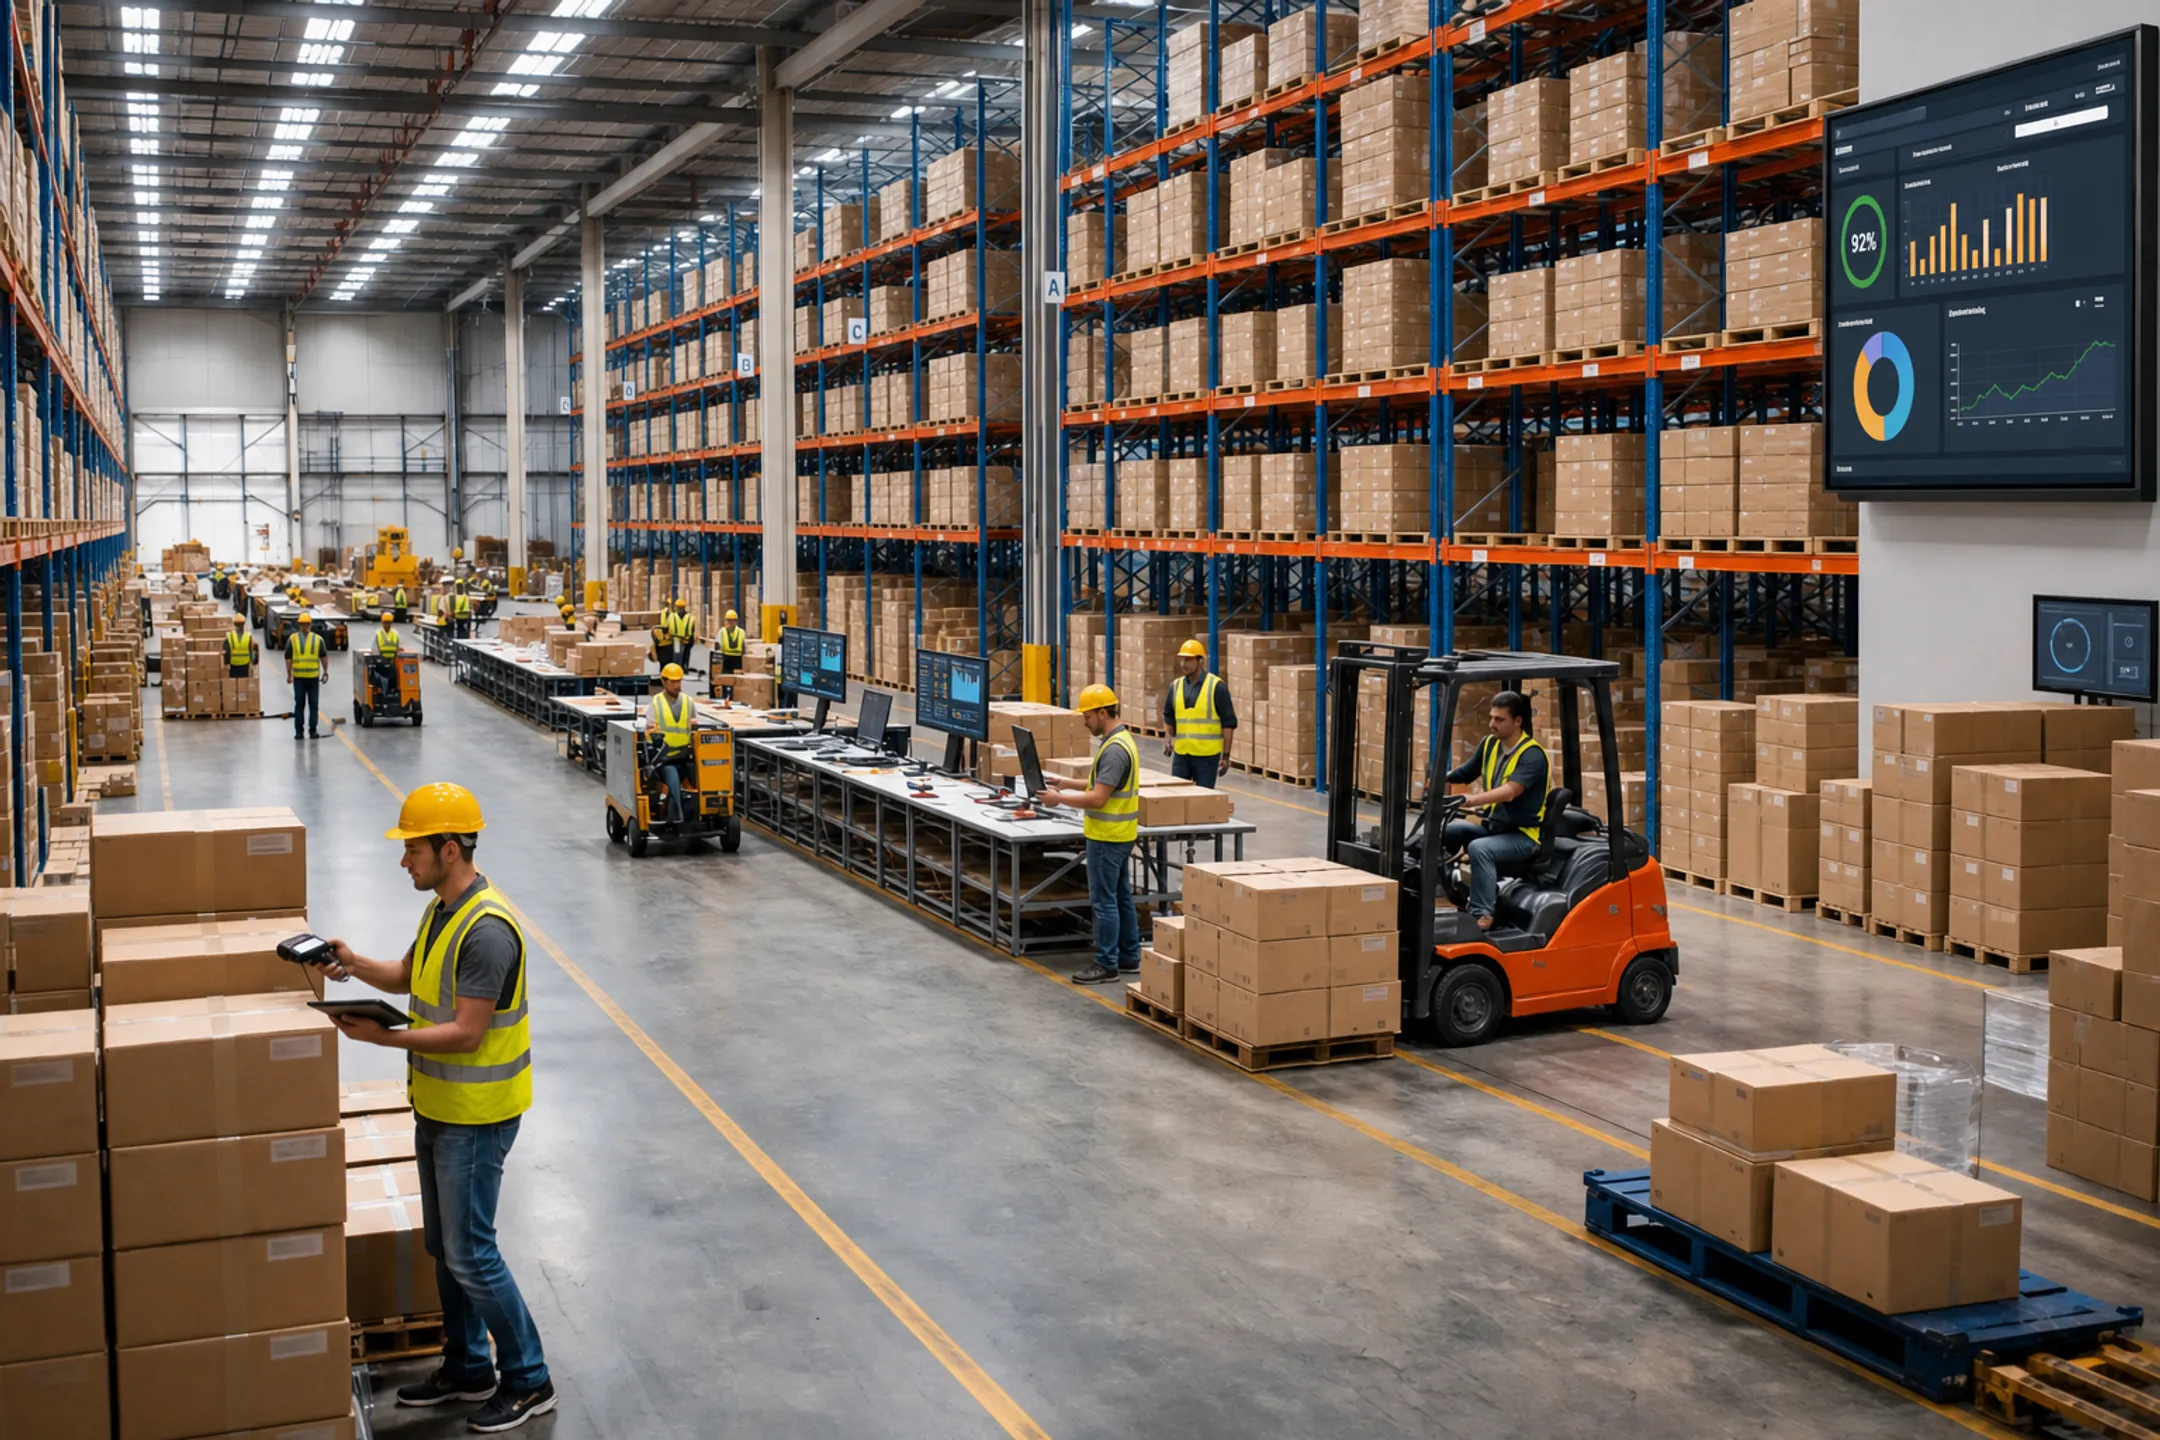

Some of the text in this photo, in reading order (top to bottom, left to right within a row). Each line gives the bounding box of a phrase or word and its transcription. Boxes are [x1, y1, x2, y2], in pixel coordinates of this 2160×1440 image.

[1851, 231, 1877, 253] 92%
[1048, 278, 1060, 296] A
[852, 324, 862, 339] C
[742, 358, 751, 372] B
